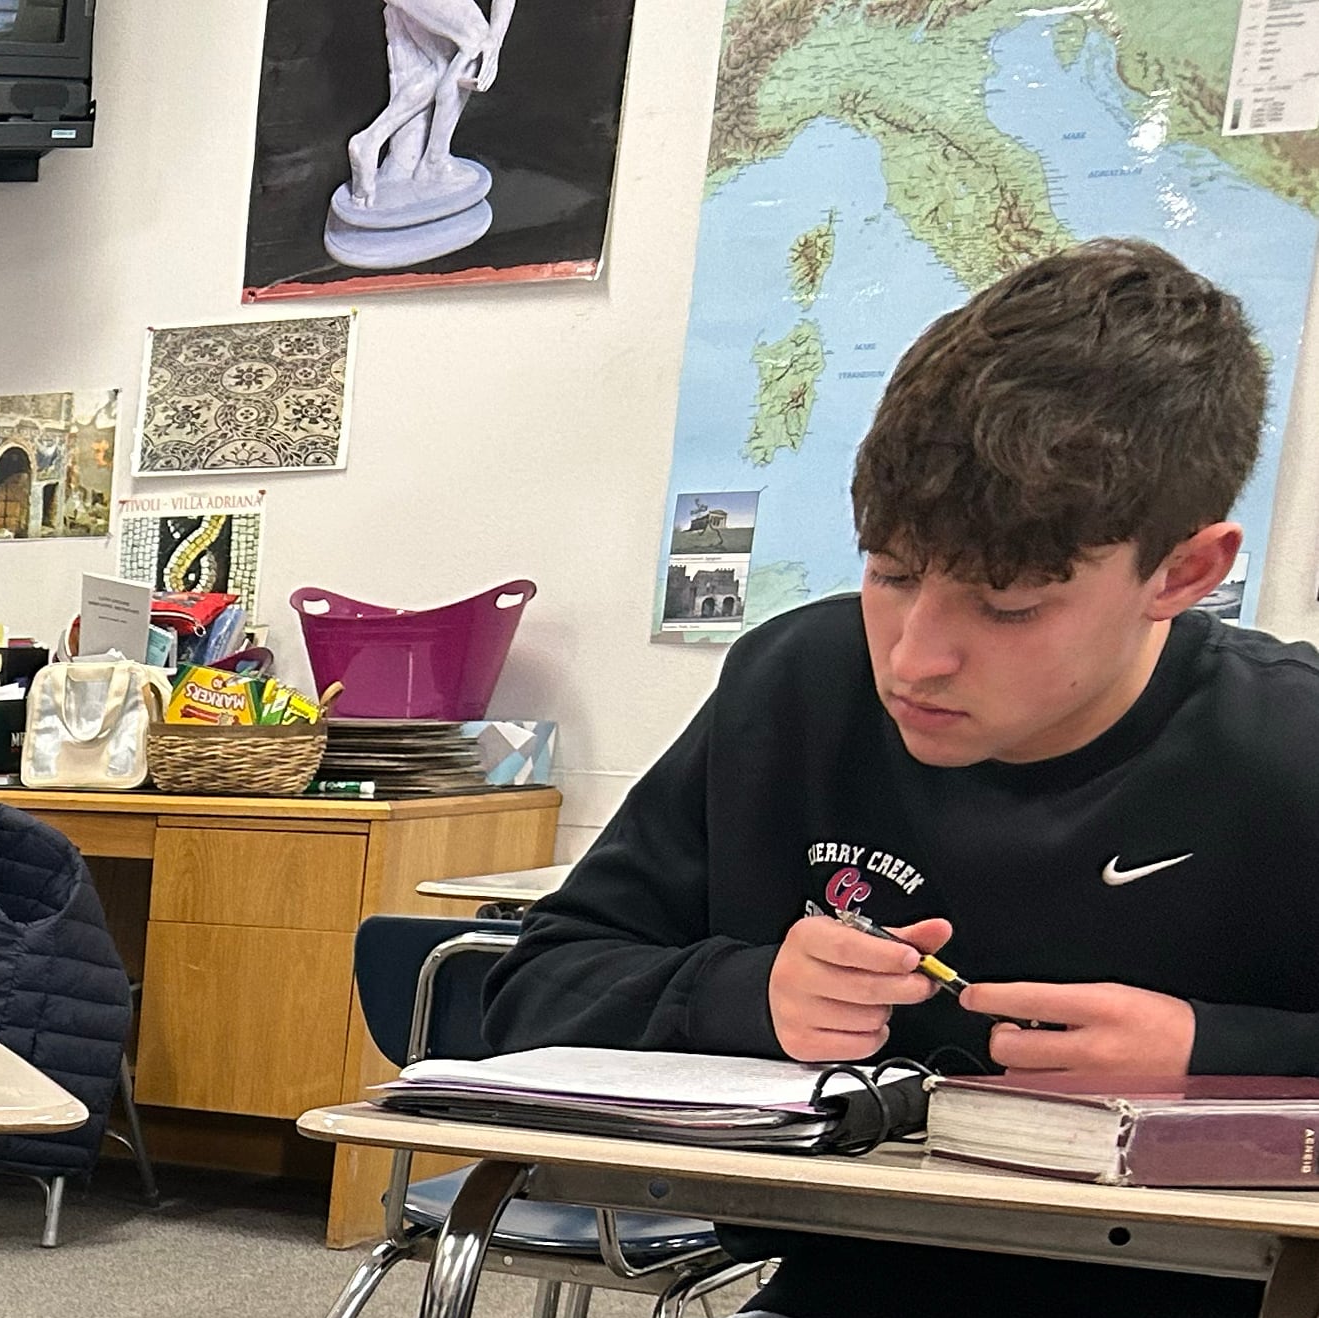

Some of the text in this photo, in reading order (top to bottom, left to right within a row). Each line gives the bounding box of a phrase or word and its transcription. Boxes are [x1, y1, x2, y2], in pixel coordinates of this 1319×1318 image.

[171, 497, 204, 511] VILLA
[206, 495, 262, 510] ADRIANA
[185, 682, 246, 711] MARKERS
[866, 850, 925, 895] CREEK
[1301, 1128, 1315, 1173] AENEID
